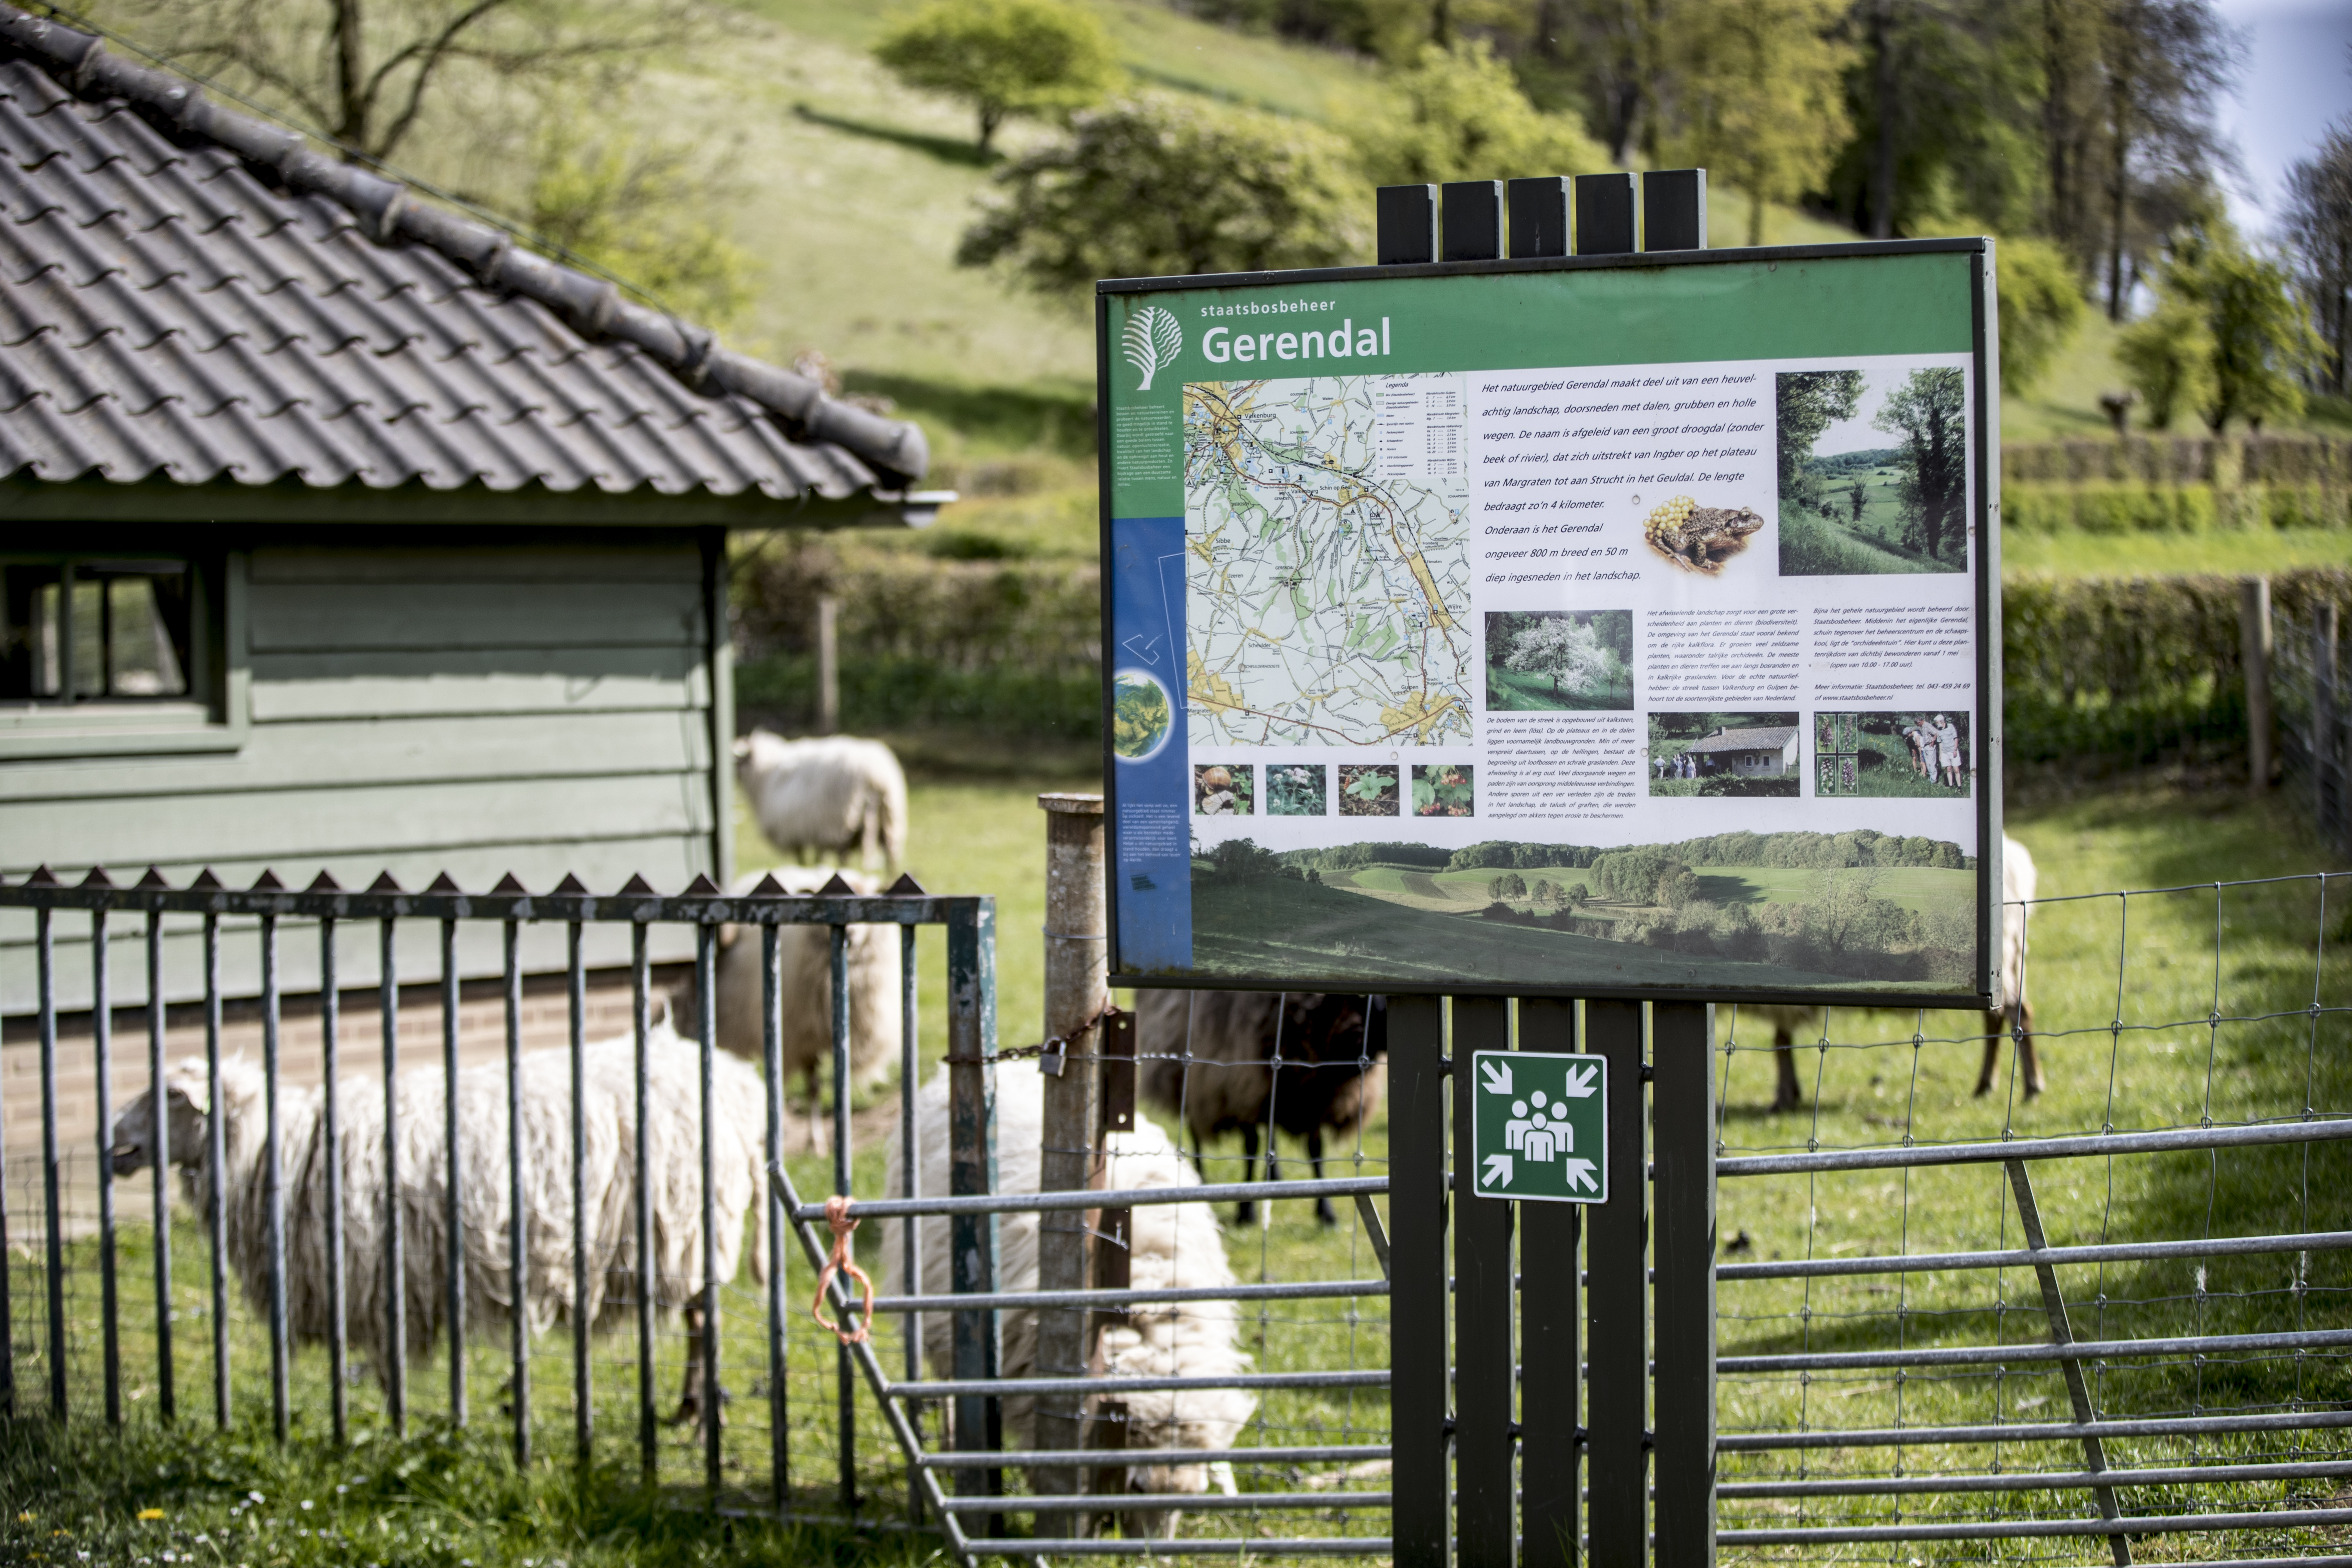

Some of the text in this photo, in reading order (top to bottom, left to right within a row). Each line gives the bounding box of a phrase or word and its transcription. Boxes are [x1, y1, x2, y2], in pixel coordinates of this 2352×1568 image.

[1201, 299, 1335, 317] staatsbosbeheer
[1202, 317, 1390, 364] Gerendal
[1482, 384, 1499, 392] Het
[1501, 381, 1565, 393] natuurgebied
[1566, 379, 1609, 389] Gerendal
[1611, 378, 1641, 387] maakt
[1643, 377, 1664, 386] deel
[1666, 377, 1679, 386] uit
[1721, 374, 1756, 383] heuvel-
[1482, 407, 1511, 417] achtig
[1513, 405, 1560, 416] landschap,
[1564, 403, 1619, 413] doorsneden
[1621, 403, 1641, 411] met
[1643, 401, 1670, 411] dalen,
[1673, 400, 1715, 411] grubben
[1732, 398, 1756, 407] holle
[1483, 432, 1515, 441] wegen.
[1519, 430, 1532, 438] De
[1562, 429, 1570, 437] is
[1572, 427, 1611, 439] afgeleid
[1651, 426, 1679, 437] groot
[1681, 423, 1726, 435] droogdal
[1727, 422, 1764, 433] (zonder
[1483, 454, 1506, 463] beek
[1508, 453, 1520, 462] of
[1520, 453, 1549, 463] rivier),
[1553, 453, 1569, 461] dat
[1570, 452, 1589, 461] zich
[1592, 450, 1632, 460] uitstrekt
[1653, 449, 1685, 460] Ingber
[1687, 450, 1699, 459] op
[1702, 448, 1718, 456] het
[1719, 447, 1757, 458] plateau
[1503, 478, 1551, 488] Margraten
[1590, 475, 1624, 484] Strucht
[1626, 475, 1635, 483] in
[1638, 474, 1654, 483] het
[1657, 472, 1694, 482] Geuldal.
[1698, 473, 1711, 481] De
[1714, 472, 1744, 483] lengte
[1484, 502, 1526, 512] bedraagt
[1550, 501, 1557, 509] 4
[1559, 500, 1605, 509] kilometer.
[1485, 523, 1604, 534] Onderaan is het Gerendal
[1485, 551, 1528, 560] ongeveer
[1530, 549, 1547, 557] 800
[1561, 548, 1589, 557] breed
[1605, 547, 1617, 556] 50
[1485, 570, 1641, 584] diep ingesneden in het landschap.
